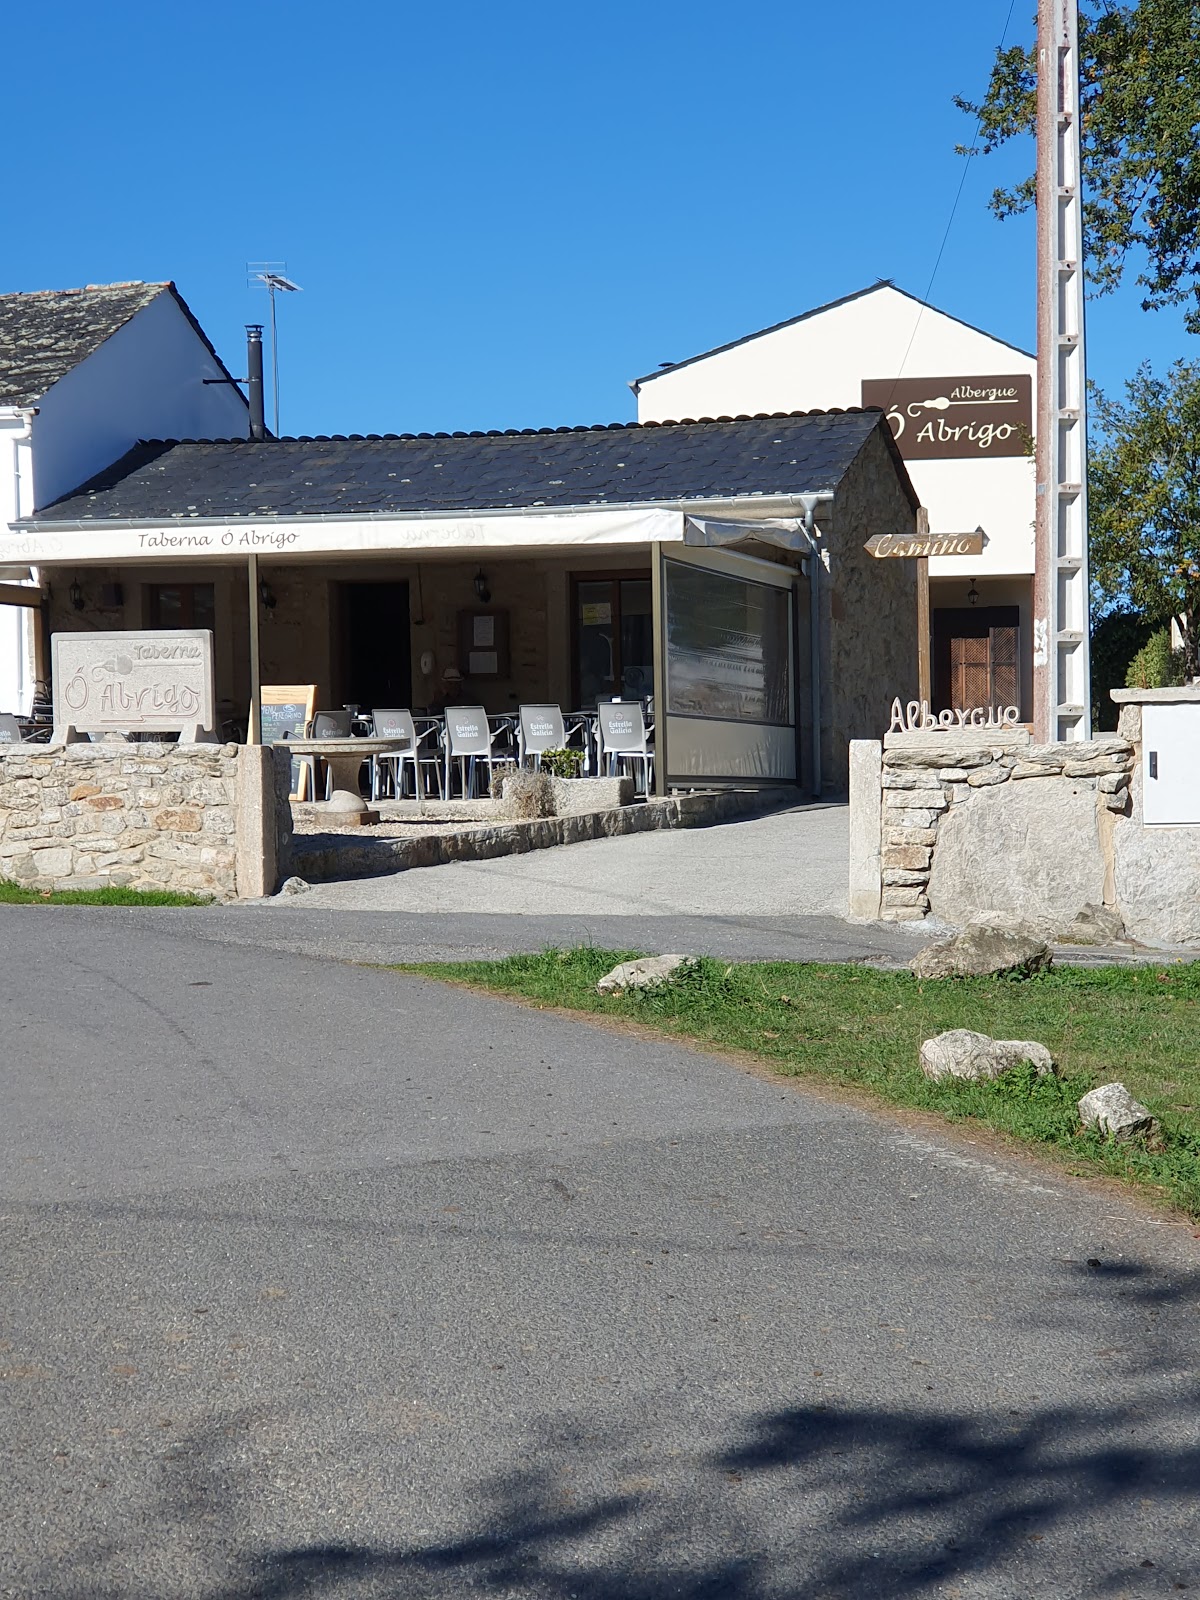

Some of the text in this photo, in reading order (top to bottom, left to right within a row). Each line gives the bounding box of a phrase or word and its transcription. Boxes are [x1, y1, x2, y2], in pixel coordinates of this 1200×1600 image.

[951, 385, 1017, 401] Albergue
[916, 419, 1018, 448] Abrigo
[138, 529, 300, 549] Taberna Ó Abrigo
[874, 533, 972, 558] Camiño
[133, 645, 202, 660] Taberna
[65, 666, 201, 713] Ó Abrigo
